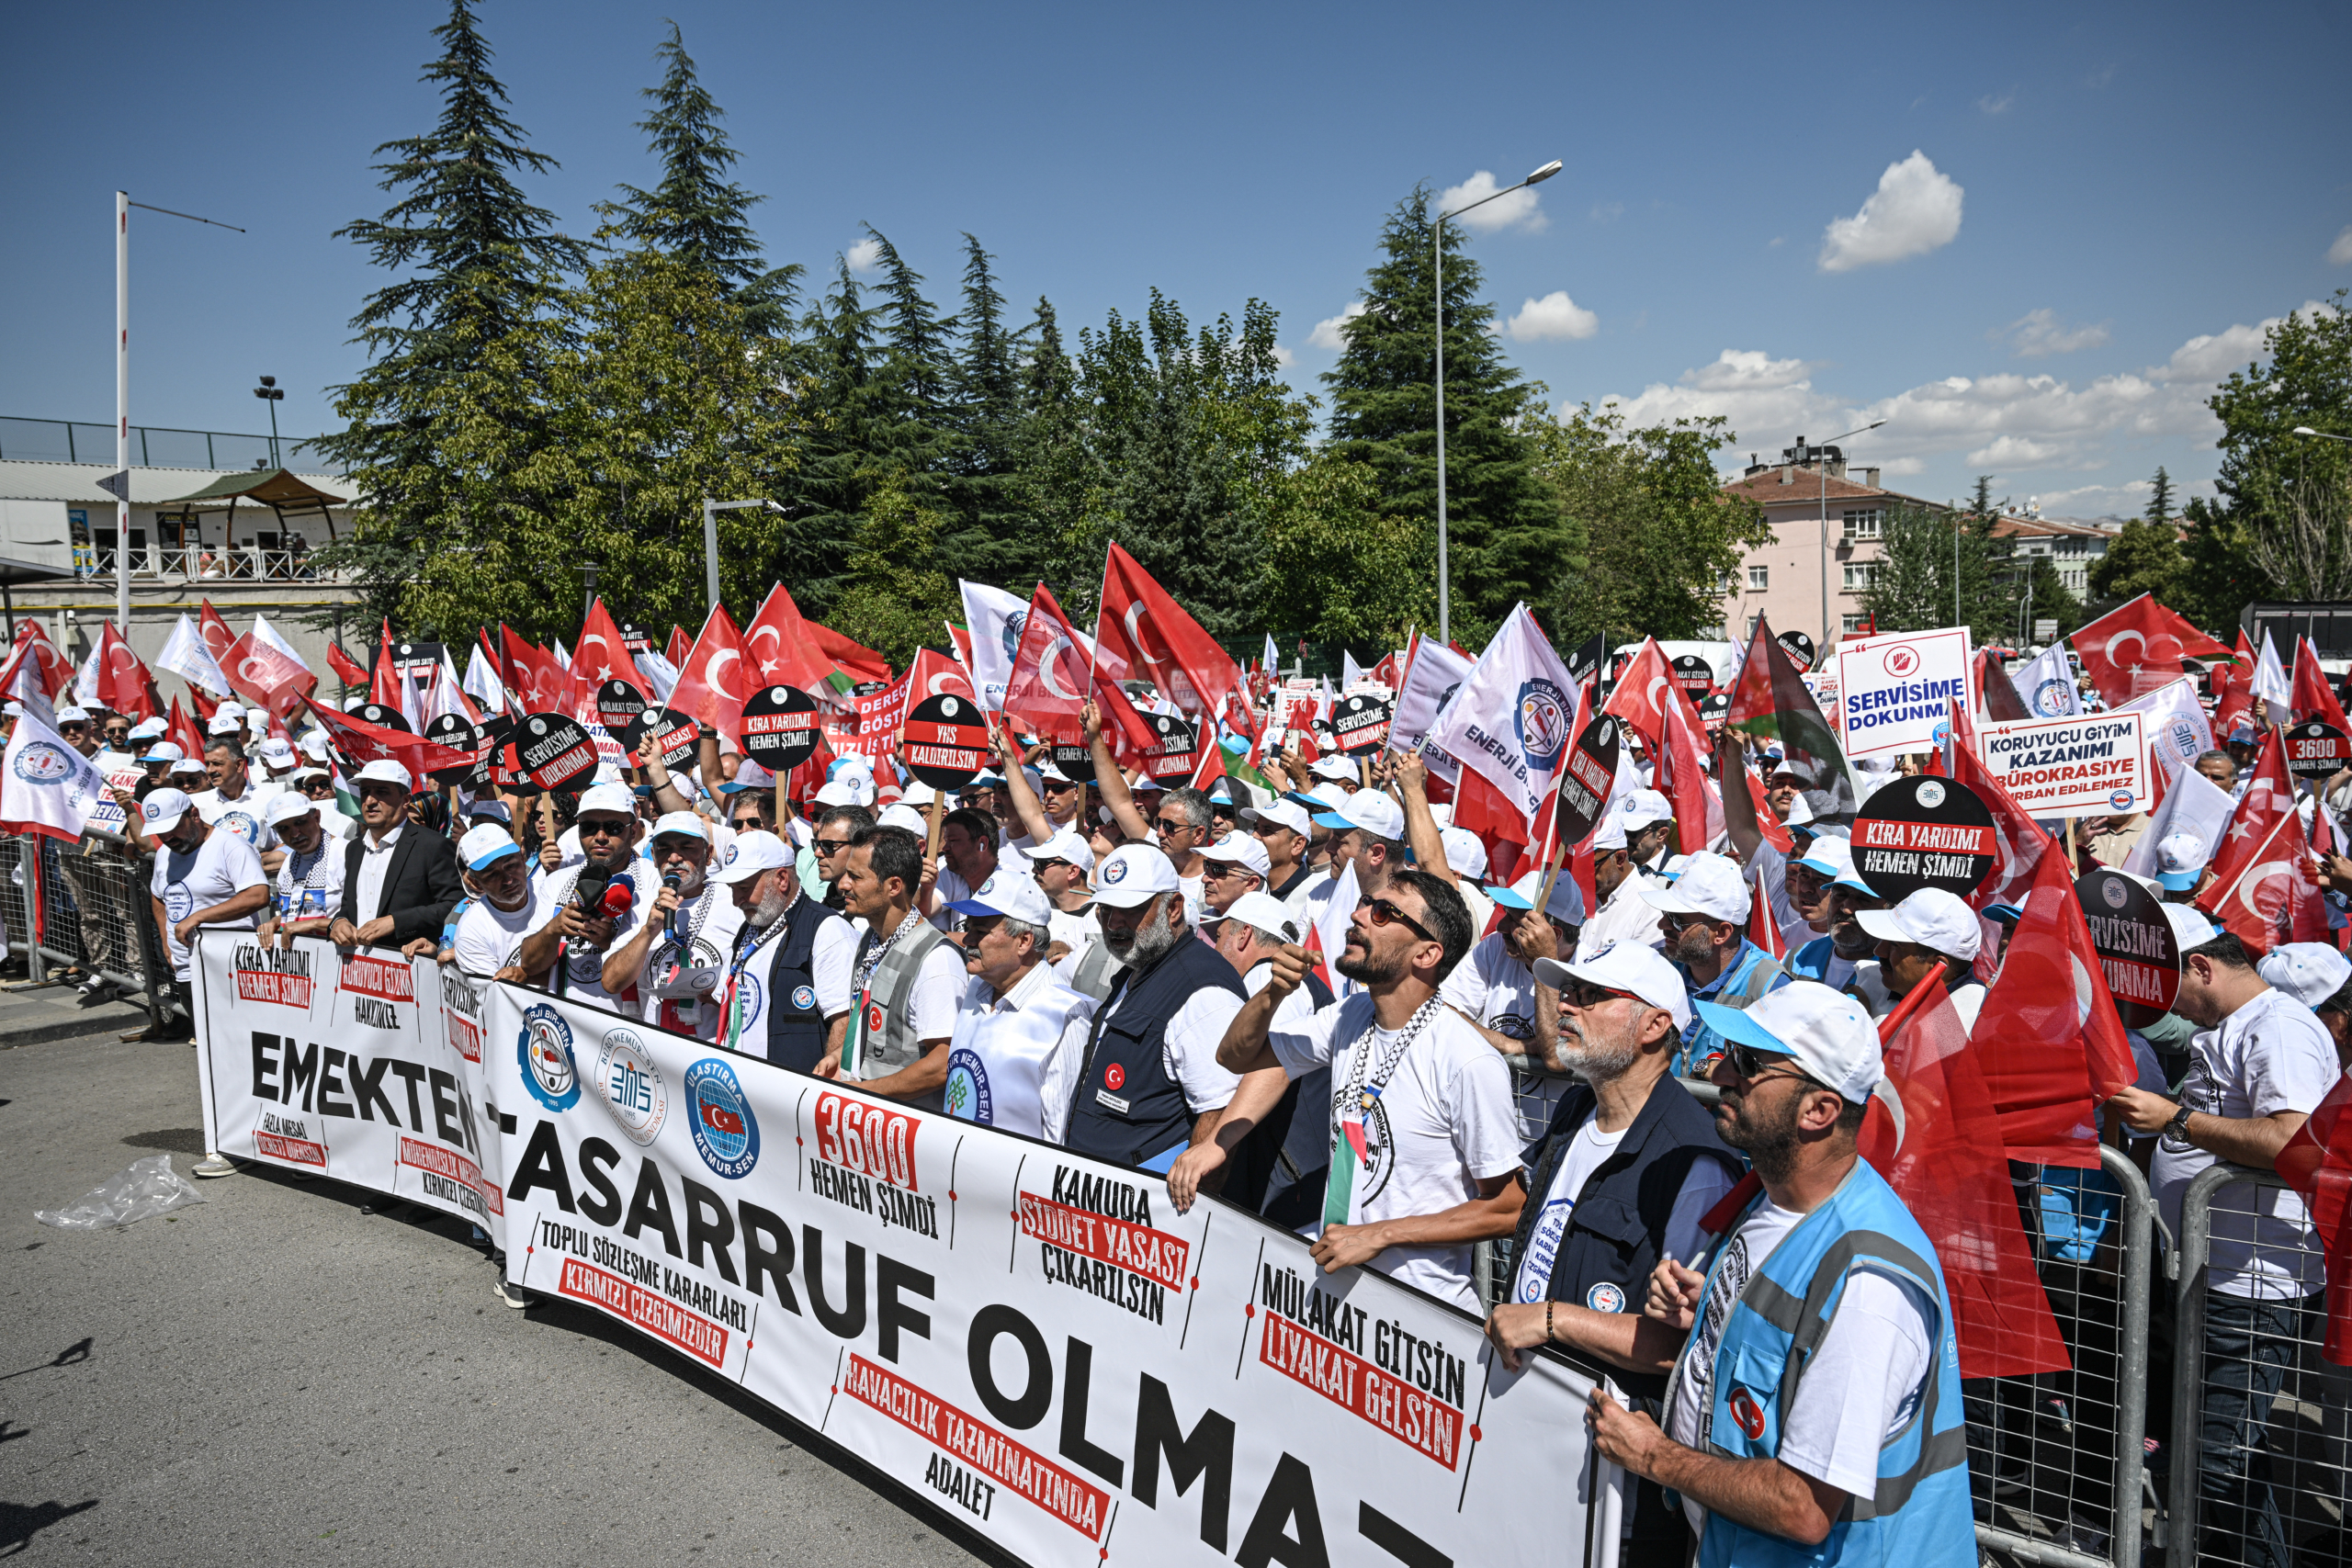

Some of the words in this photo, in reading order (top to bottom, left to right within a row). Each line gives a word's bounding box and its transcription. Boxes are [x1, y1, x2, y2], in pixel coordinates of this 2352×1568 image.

[1848, 678, 1964, 714] SERVİSİME
[748, 715, 770, 732] KİRA
[771, 713, 811, 730] YARDIMI
[937, 726, 957, 744] YHS
[1338, 706, 1385, 732] SERVİSİME
[524, 724, 582, 768] SERVİSİME
[750, 734, 780, 750] HEMEN
[782, 731, 809, 750] ŞİMDİ
[911, 745, 977, 770] KALDIRILSIN
[1464, 724, 1521, 771] ENERJİ
[1990, 727, 2081, 753] KORUYUCU
[2009, 741, 2113, 769] KAZANIMI
[2296, 739, 2335, 759] 3600
[539, 746, 594, 787] DOKUNMA
[1866, 820, 1905, 845] KİRA
[1910, 825, 1983, 851] YARDIMI
[1865, 851, 1918, 875] HEMEN
[1923, 852, 1974, 879] ŞİMDİ
[235, 942, 265, 972] KİRA
[343, 957, 382, 992] KORUYUCU
[239, 972, 279, 1001] HEMEN
[281, 973, 311, 1007] ŞİMDİ
[545, 1010, 570, 1047] BİR-SEN
[687, 1062, 742, 1104] ULAŞTIRMA
[282, 1118, 308, 1140] MESAİ
[624, 1110, 636, 1121] 1995
[257, 1132, 286, 1161] ÜCRETİ
[695, 1132, 754, 1175] MEMUR-SEN
[820, 1097, 910, 1188] 3600
[422, 1171, 458, 1203] KIRMIZI
[810, 1158, 873, 1215] HEMEN
[876, 1181, 939, 1240] ŞİMDİ
[1052, 1164, 1152, 1228] KAMUDA
[1021, 1197, 1096, 1253] ŞİDDET
[1103, 1221, 1185, 1288] YASASI
[542, 1220, 588, 1258] TOPLU
[593, 1235, 660, 1290] SÖZLEŞME
[664, 1267, 747, 1333] KARARLARI
[1042, 1243, 1165, 1326] ÇIKARILSIN
[252, 1031, 483, 1170] EMEKTEN
[485, 1102, 934, 1364] TASARRUF
[967, 1303, 1454, 1568] OLMA
[566, 1262, 628, 1313] KIRMIZI
[630, 1289, 721, 1361] ÇİZGİMİZDİR
[1262, 1262, 1367, 1356] MÜLAKAT
[1374, 1319, 1465, 1410] GİTSİN
[1267, 1318, 1358, 1406] LİYAKAT
